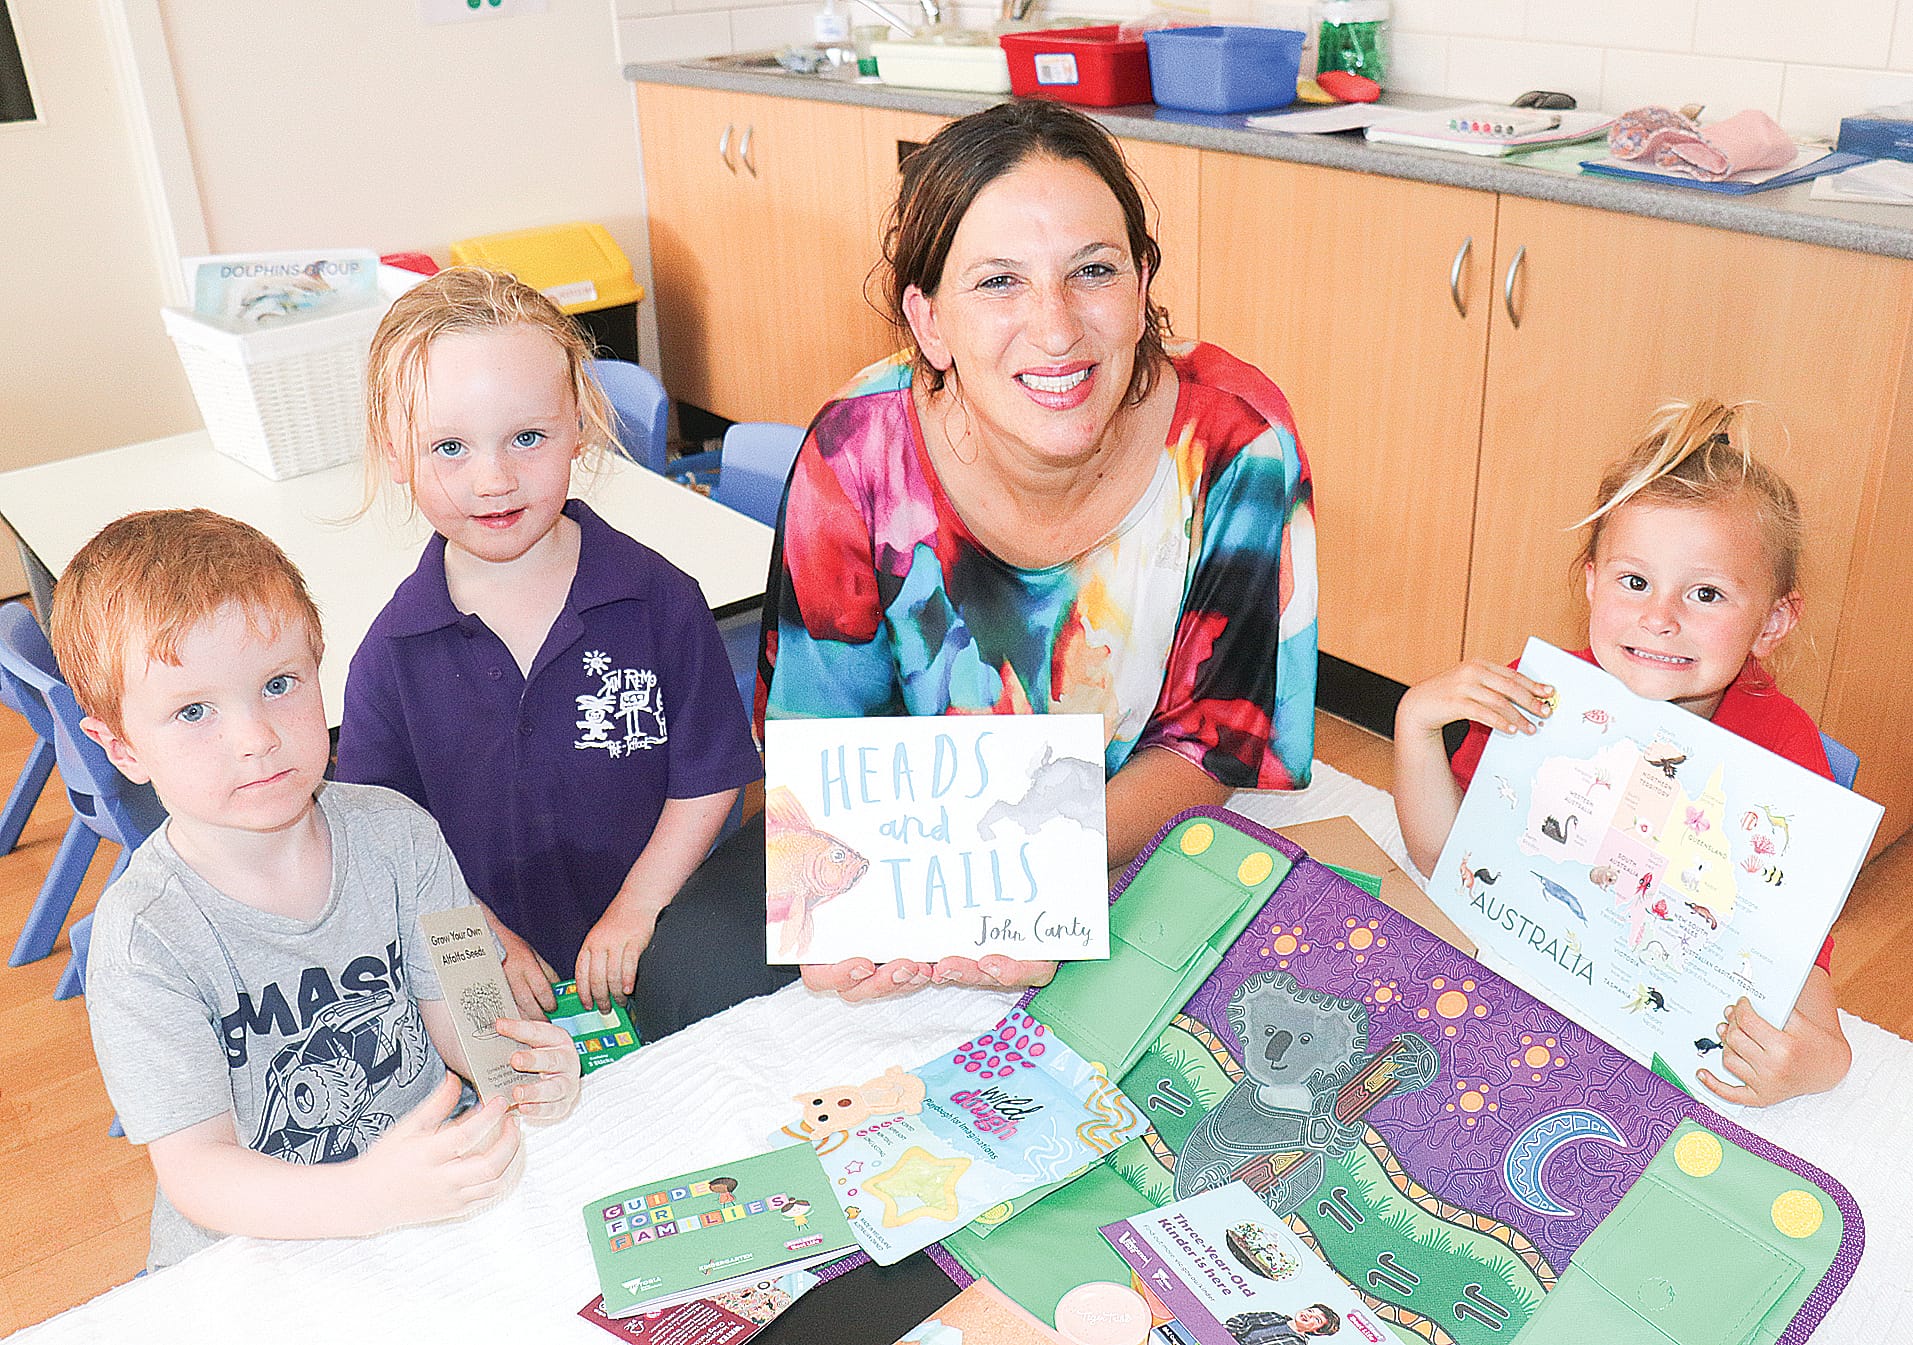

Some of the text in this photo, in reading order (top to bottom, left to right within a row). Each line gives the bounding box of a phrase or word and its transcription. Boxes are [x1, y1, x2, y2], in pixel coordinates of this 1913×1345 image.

[221, 262, 360, 278] DOLPHINS GROUP
[821, 732, 993, 816] HEADS
[1570, 792, 1593, 806] WESTERN
[1640, 778, 1669, 797] TERRITORY
[1564, 797, 1592, 815] AUSTRALIA
[880, 806, 950, 844] and
[1689, 834, 1726, 859] QUEENSLAND
[1609, 858, 1638, 877] AUSTRALIA
[1618, 853, 1636, 865] SOUTH
[880, 842, 1038, 919] TAILS
[974, 910, 1094, 946] John Canty
[1674, 913, 1686, 923] NEW
[1688, 921, 1708, 935] SOUTH
[1679, 925, 1697, 938] WALES
[430, 927, 483, 946] Grow Your Own
[1470, 891, 1596, 987] AUSTRALIA
[442, 946, 486, 966] Alfalfa Seeds
[1614, 949, 1641, 967] VICTORIA
[1682, 947, 1713, 967] AUSTRALIAN
[1714, 965, 1735, 982] CAPITAL
[1737, 979, 1765, 1000] TERRITORY
[1604, 978, 1630, 998] TASMANIA
[576, 1035, 630, 1053] HALK
[950, 1089, 1019, 1140] dough
[979, 1085, 1045, 1123] wild
[950, 1116, 961, 1124] for
[959, 1123, 998, 1159] Imaginations
[605, 1181, 709, 1219] GUIDE
[611, 1209, 668, 1233] FOR
[615, 1196, 786, 1250] FAMILIES
[1157, 1218, 1232, 1297] Kinder is here
[1172, 1213, 1257, 1298] Three-Year-Old
